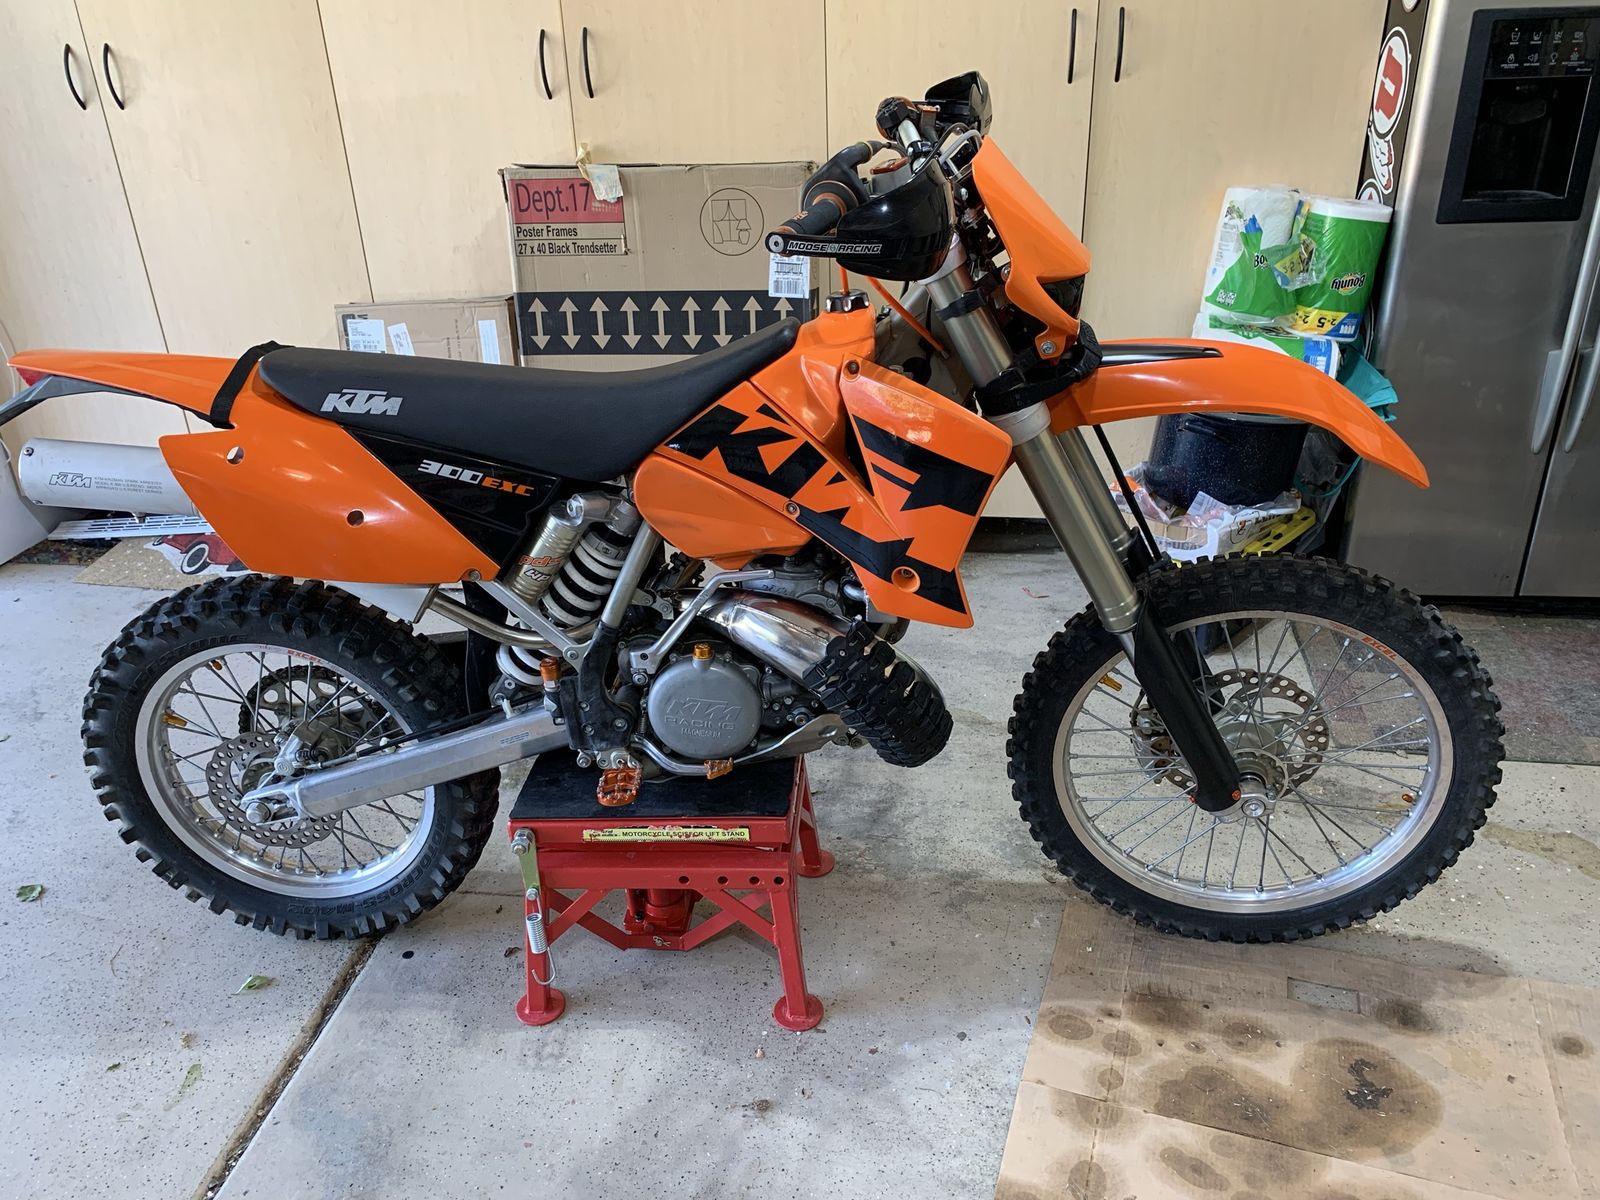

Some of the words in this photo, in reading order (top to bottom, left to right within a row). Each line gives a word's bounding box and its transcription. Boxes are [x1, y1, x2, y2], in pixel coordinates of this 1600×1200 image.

[515, 183, 590, 220] Dept.17
[516, 226, 544, 238] Poster
[546, 225, 578, 237] Frames
[518, 243, 528, 255] 27
[529, 246, 536, 254] x
[537, 243, 546, 254] 40
[548, 242, 570, 254] Black
[572, 242, 617, 254] Trendsetter
[787, 240, 829, 252] MOOSE
[837, 243, 883, 254] RACING
[1331, 274, 1366, 291] Bounty
[320, 388, 403, 416] KTM
[49, 471, 92, 488] KTM
[417, 459, 484, 484] 300
[481, 475, 535, 497] EXC
[1361, 635, 1398, 661] EXCEL
[664, 697, 744, 721] KTM
[705, 830, 721, 838] LIFT
[722, 830, 746, 838] STAND
